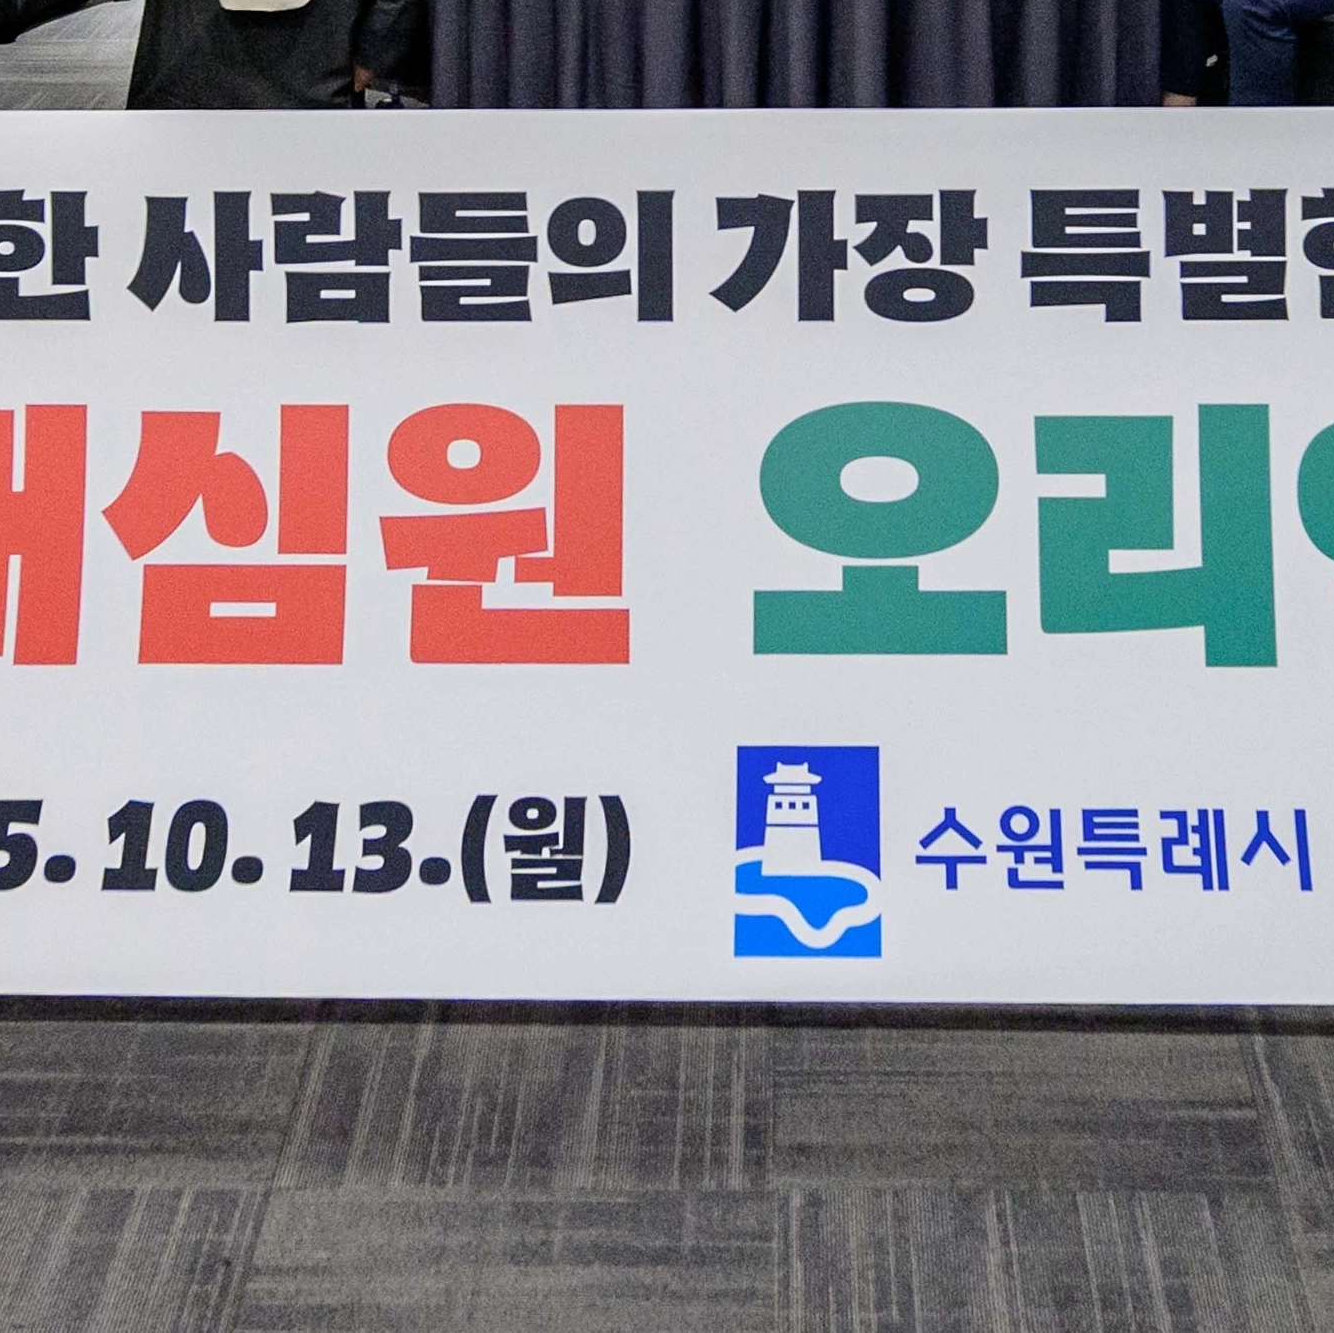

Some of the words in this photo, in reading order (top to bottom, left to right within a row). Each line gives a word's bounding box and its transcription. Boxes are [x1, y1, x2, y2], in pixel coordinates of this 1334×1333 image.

[128, 190, 675, 324] 사람들의
[711, 189, 987, 323] 가장
[102, 800, 263, 892] 10.
[290, 795, 631, 904] 13.(월)
[914, 804, 1314, 892] 수원특례시
